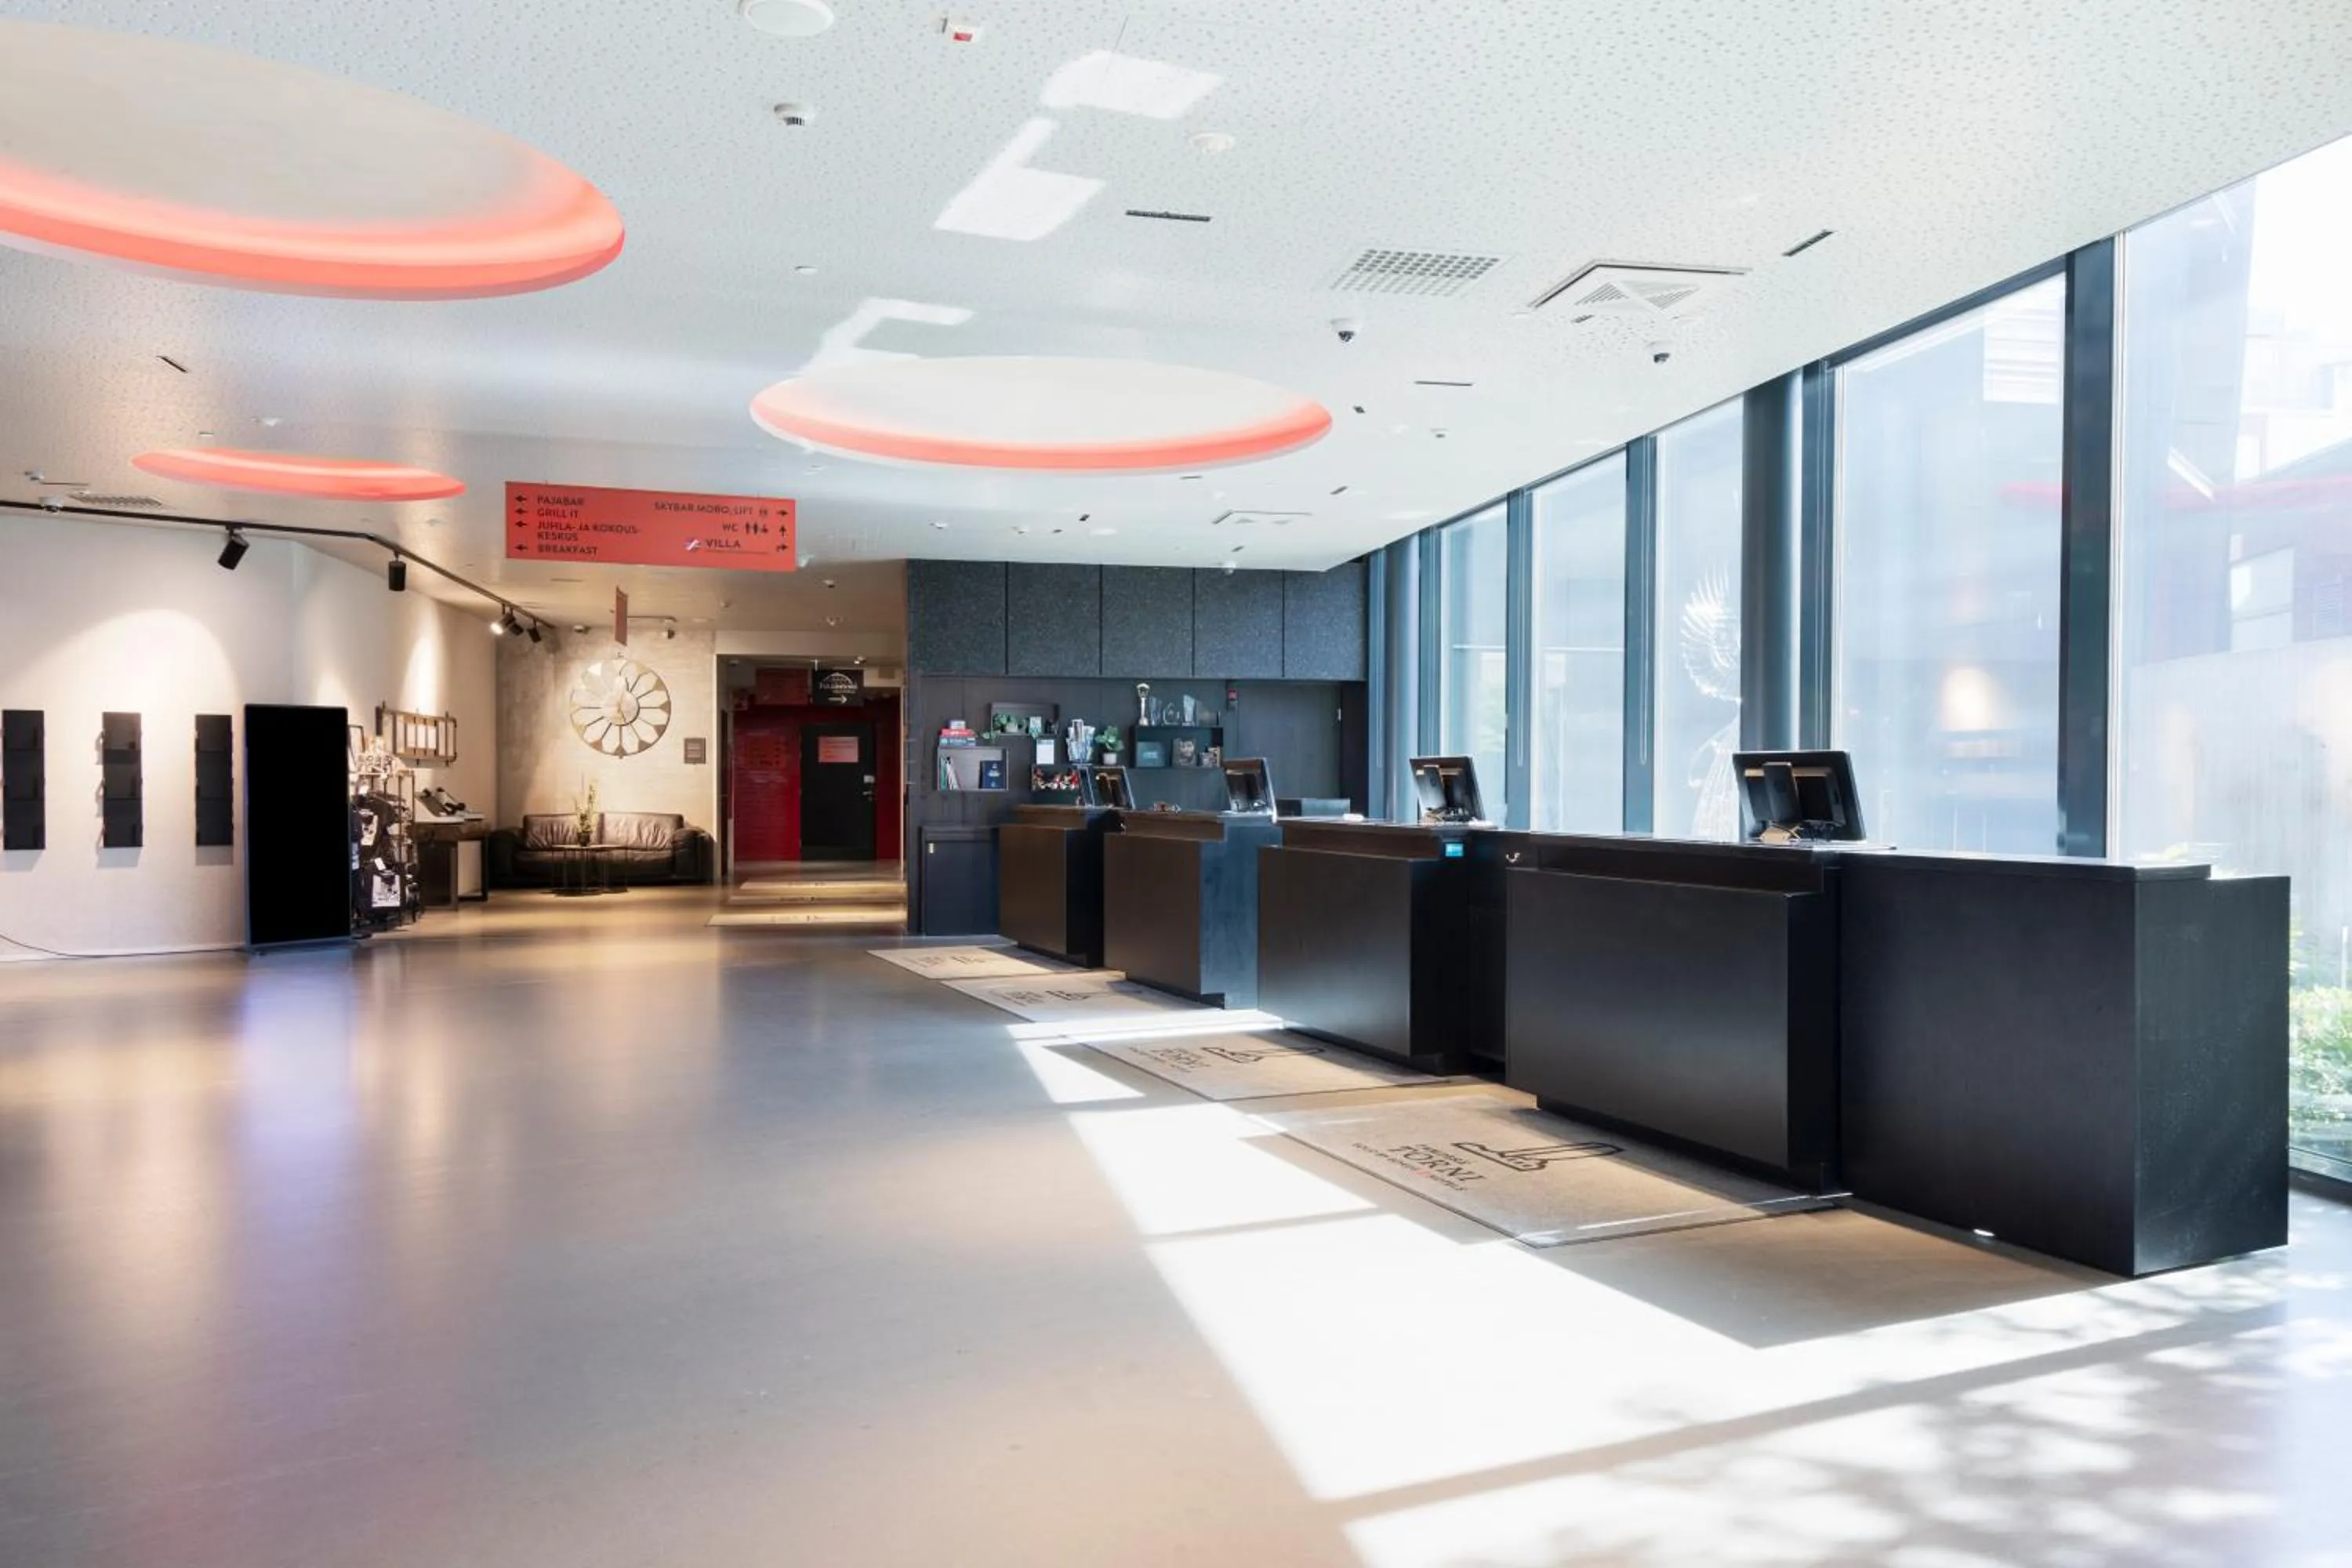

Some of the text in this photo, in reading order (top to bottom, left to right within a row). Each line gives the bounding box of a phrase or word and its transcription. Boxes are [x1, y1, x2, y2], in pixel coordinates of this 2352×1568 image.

[538, 495, 584, 505] PAJABAR
[654, 501, 694, 512] SKYBAR
[538, 508, 579, 518] GRILL IT
[538, 521, 576, 531] JUHLA-
[723, 523, 738, 532] WC
[538, 532, 578, 542] KESKUS
[706, 538, 741, 548] VILLA
[538, 546, 598, 555] BREAKFAST
[1387, 1145, 1486, 1182] TORNI
